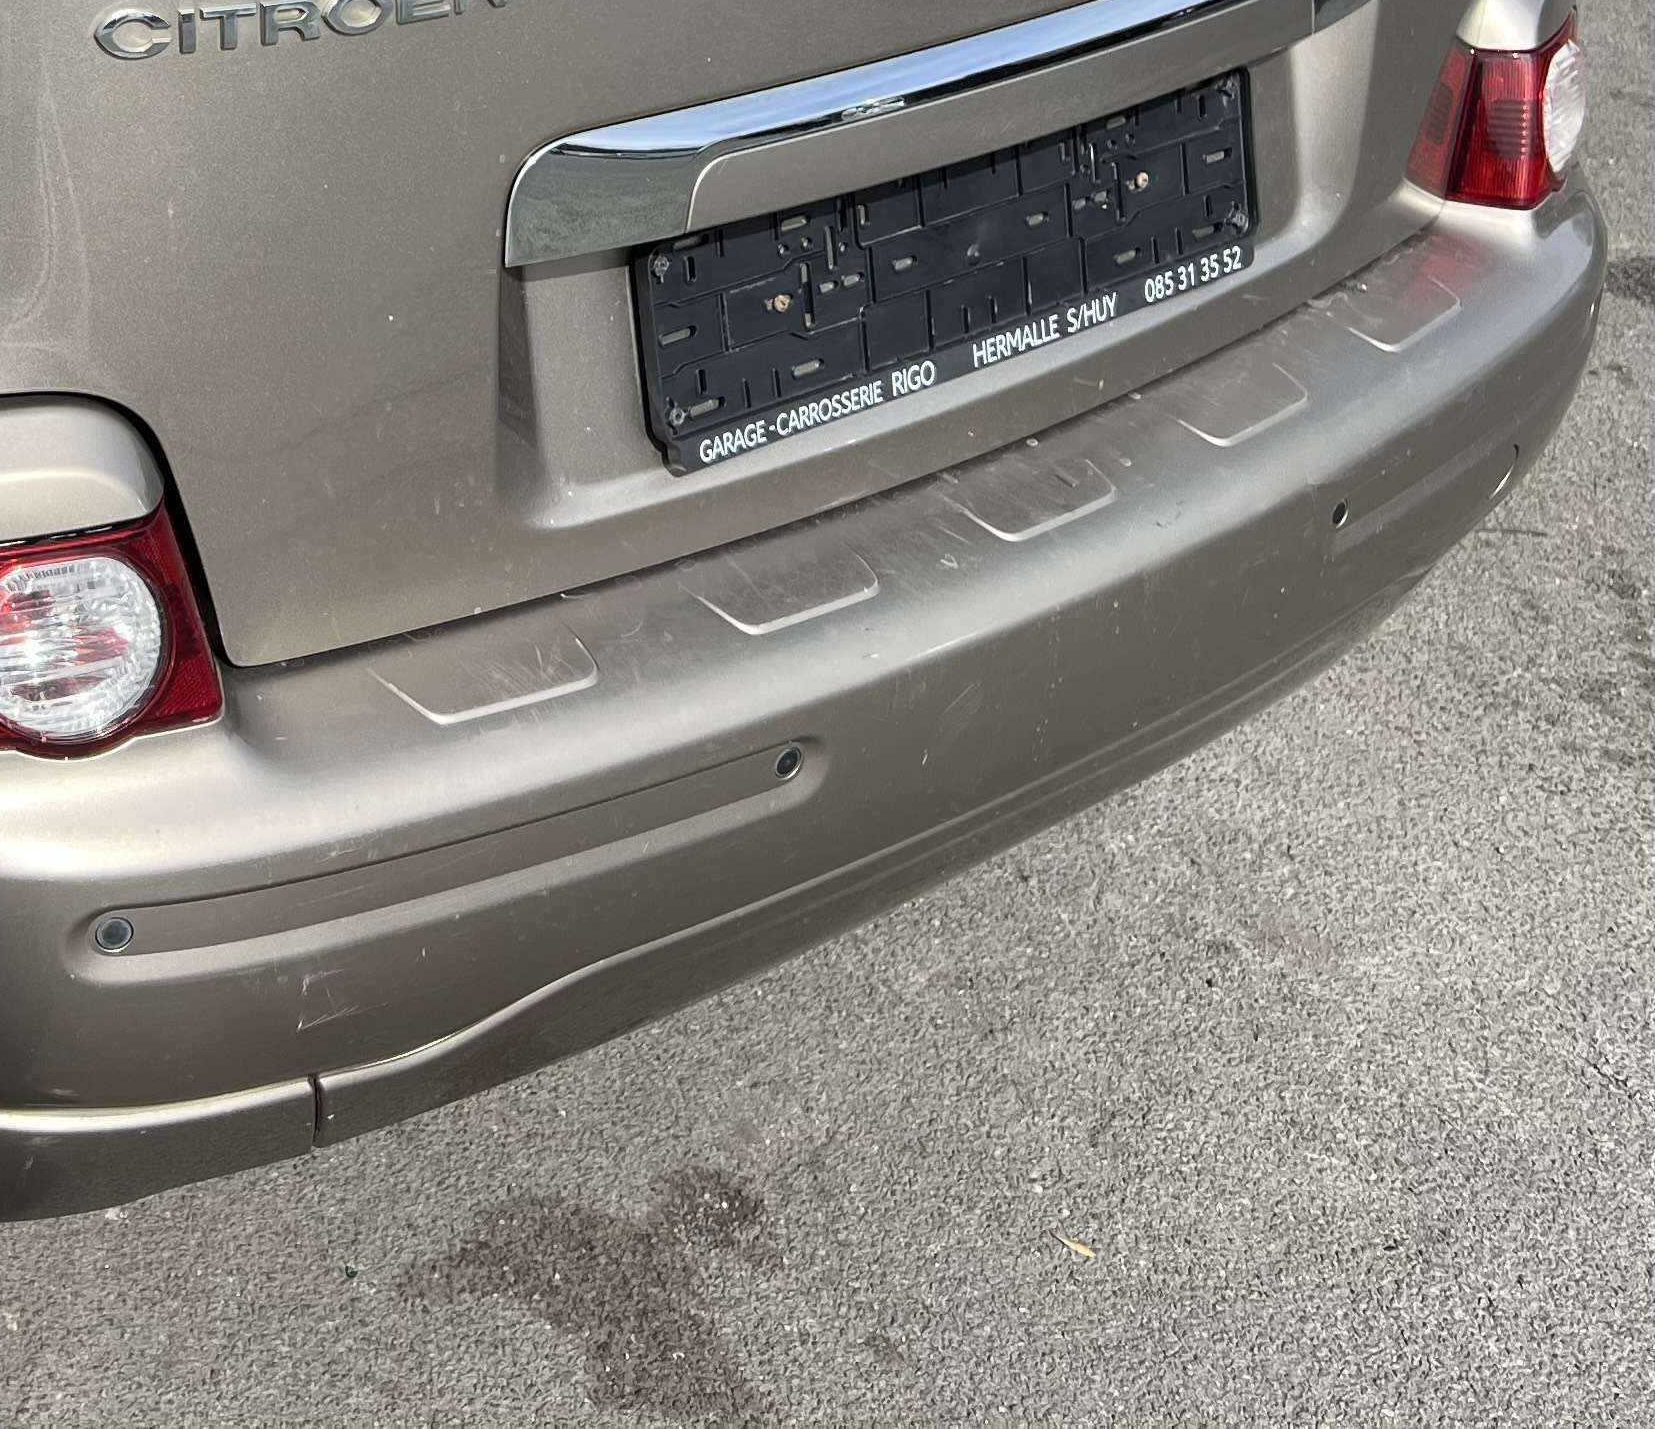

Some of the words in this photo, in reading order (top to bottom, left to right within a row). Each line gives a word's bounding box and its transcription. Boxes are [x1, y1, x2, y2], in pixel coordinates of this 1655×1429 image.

[891, 360, 937, 397] RIGO
[972, 314, 1061, 368] HERMALLE
[1066, 292, 1118, 334] S/HUY
[1144, 270, 1174, 303] 085
[1178, 262, 1195, 291] 31
[1200, 253, 1219, 282] 35
[1223, 245, 1242, 274] 52
